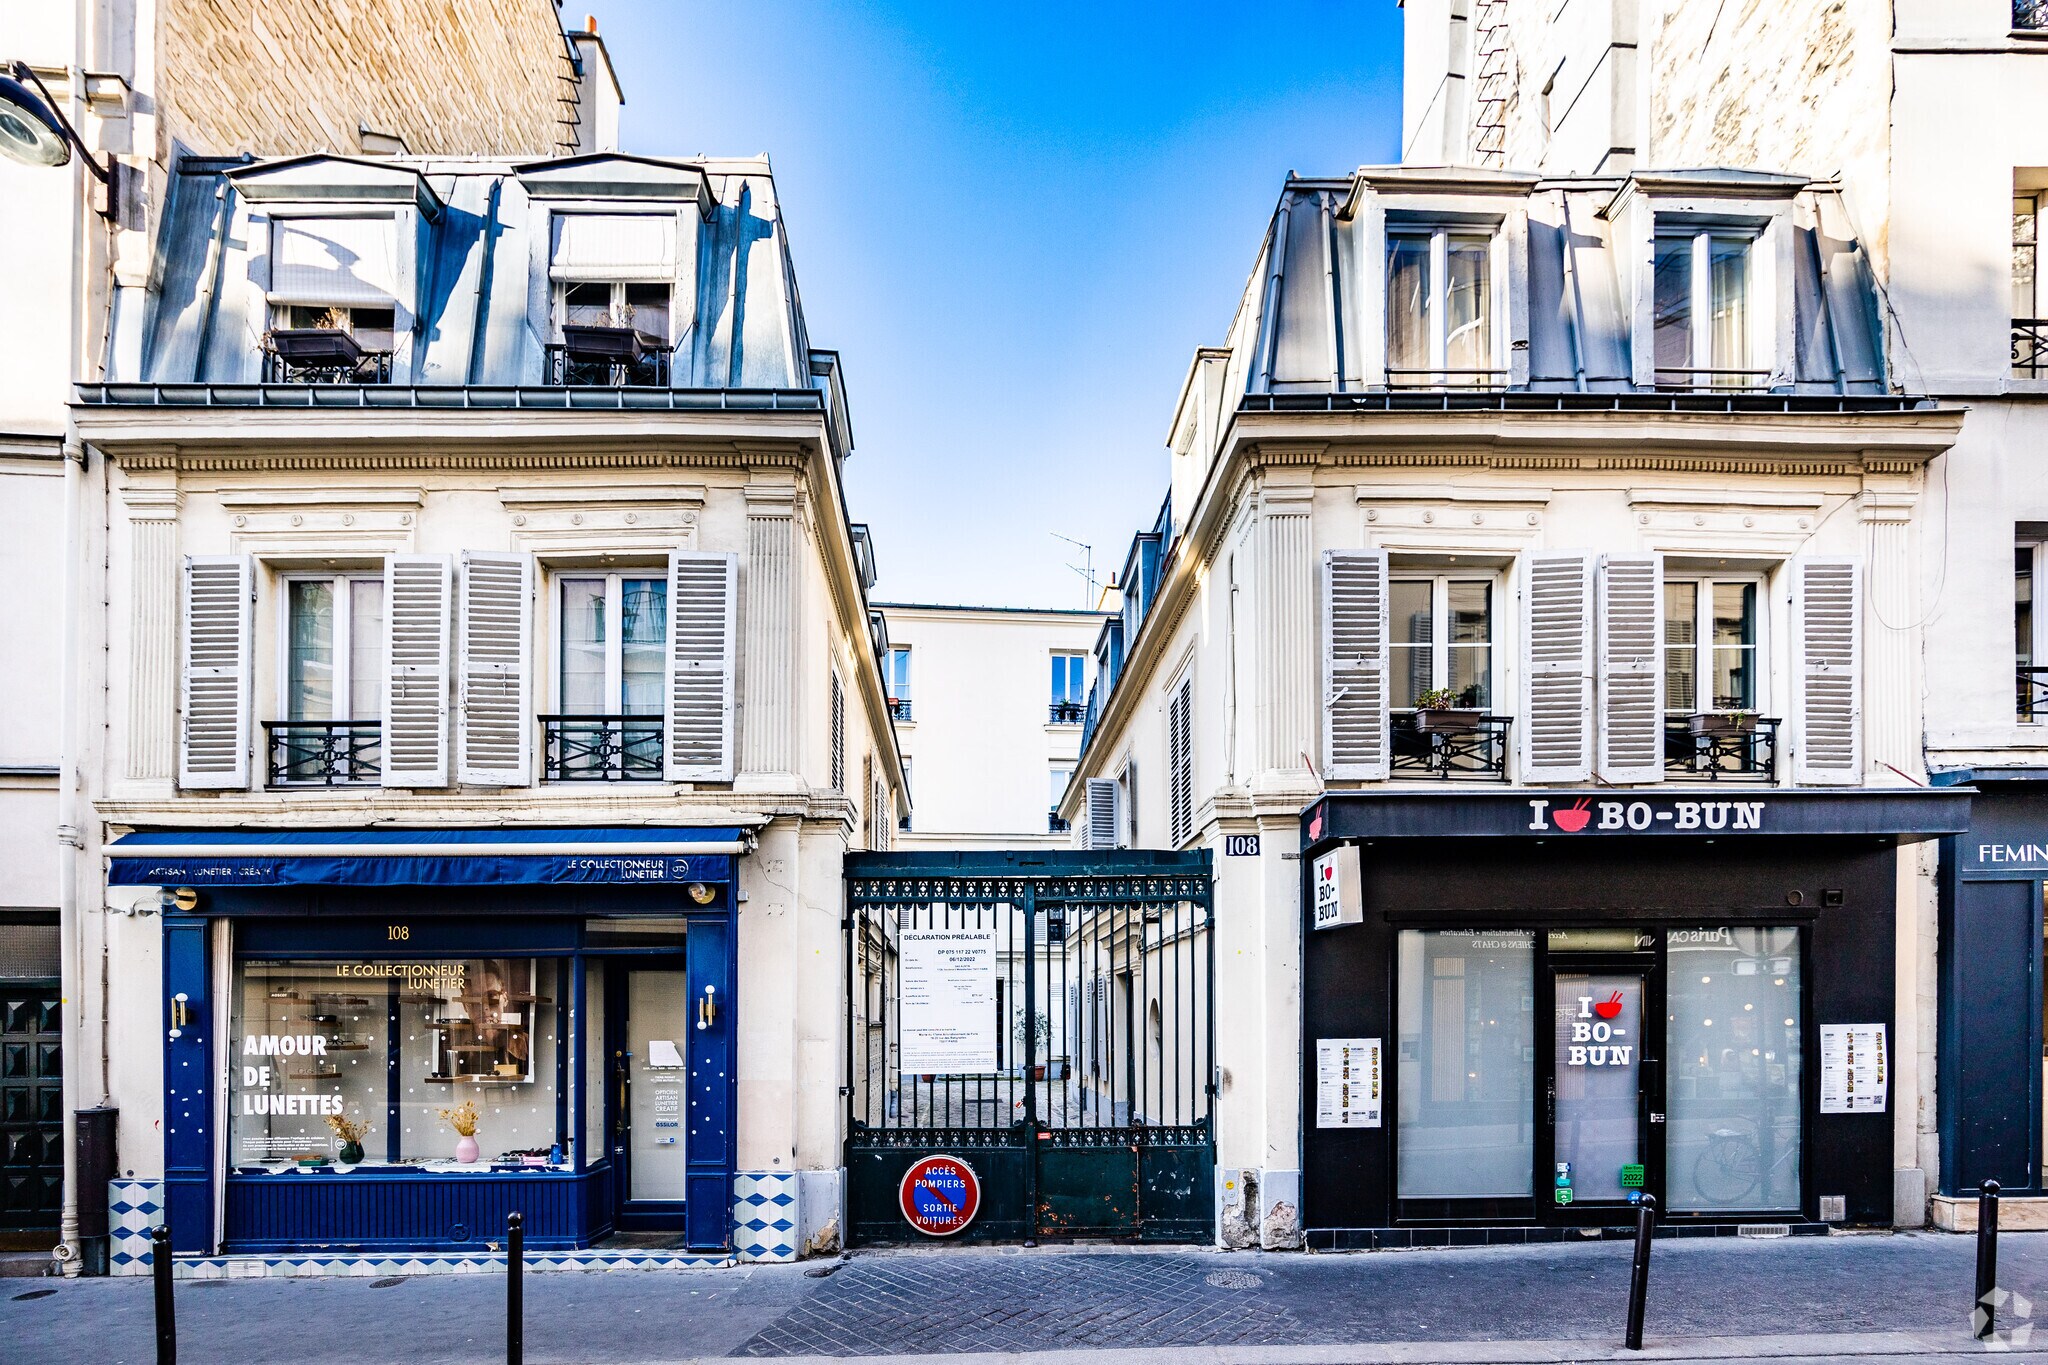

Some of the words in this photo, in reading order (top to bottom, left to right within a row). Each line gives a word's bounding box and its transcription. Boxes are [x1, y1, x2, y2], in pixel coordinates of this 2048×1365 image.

[1529, 800, 1549, 830] I
[1598, 802, 1765, 830] BO-BUN
[1228, 836, 1258, 855] 108
[567, 860, 577, 869] LE
[580, 859, 664, 869] COLLECTIONNEUR
[1319, 864, 1325, 881] I
[622, 869, 664, 879] LUNETIER
[1318, 883, 1336, 902] BO-
[1318, 901, 1338, 922] BUN
[387, 925, 410, 940] 108
[336, 965, 350, 977] LE
[353, 965, 465, 977] COLLECTIONNEUR
[408, 978, 465, 990] LUNETIER
[1578, 997, 1593, 1018] I
[1571, 1021, 1626, 1043] BO-
[243, 1035, 328, 1056] AMOUR
[1568, 1045, 1633, 1066] BUN
[243, 1065, 271, 1087] DE
[243, 1094, 344, 1116] LUNETTES
[925, 1165, 956, 1175] ACCÈS
[1623, 1173, 1643, 1181] 2022
[915, 1179, 966, 1188] POMPIERS
[923, 1203, 957, 1212] SORTIE
[916, 1216, 964, 1225] VOITURES
